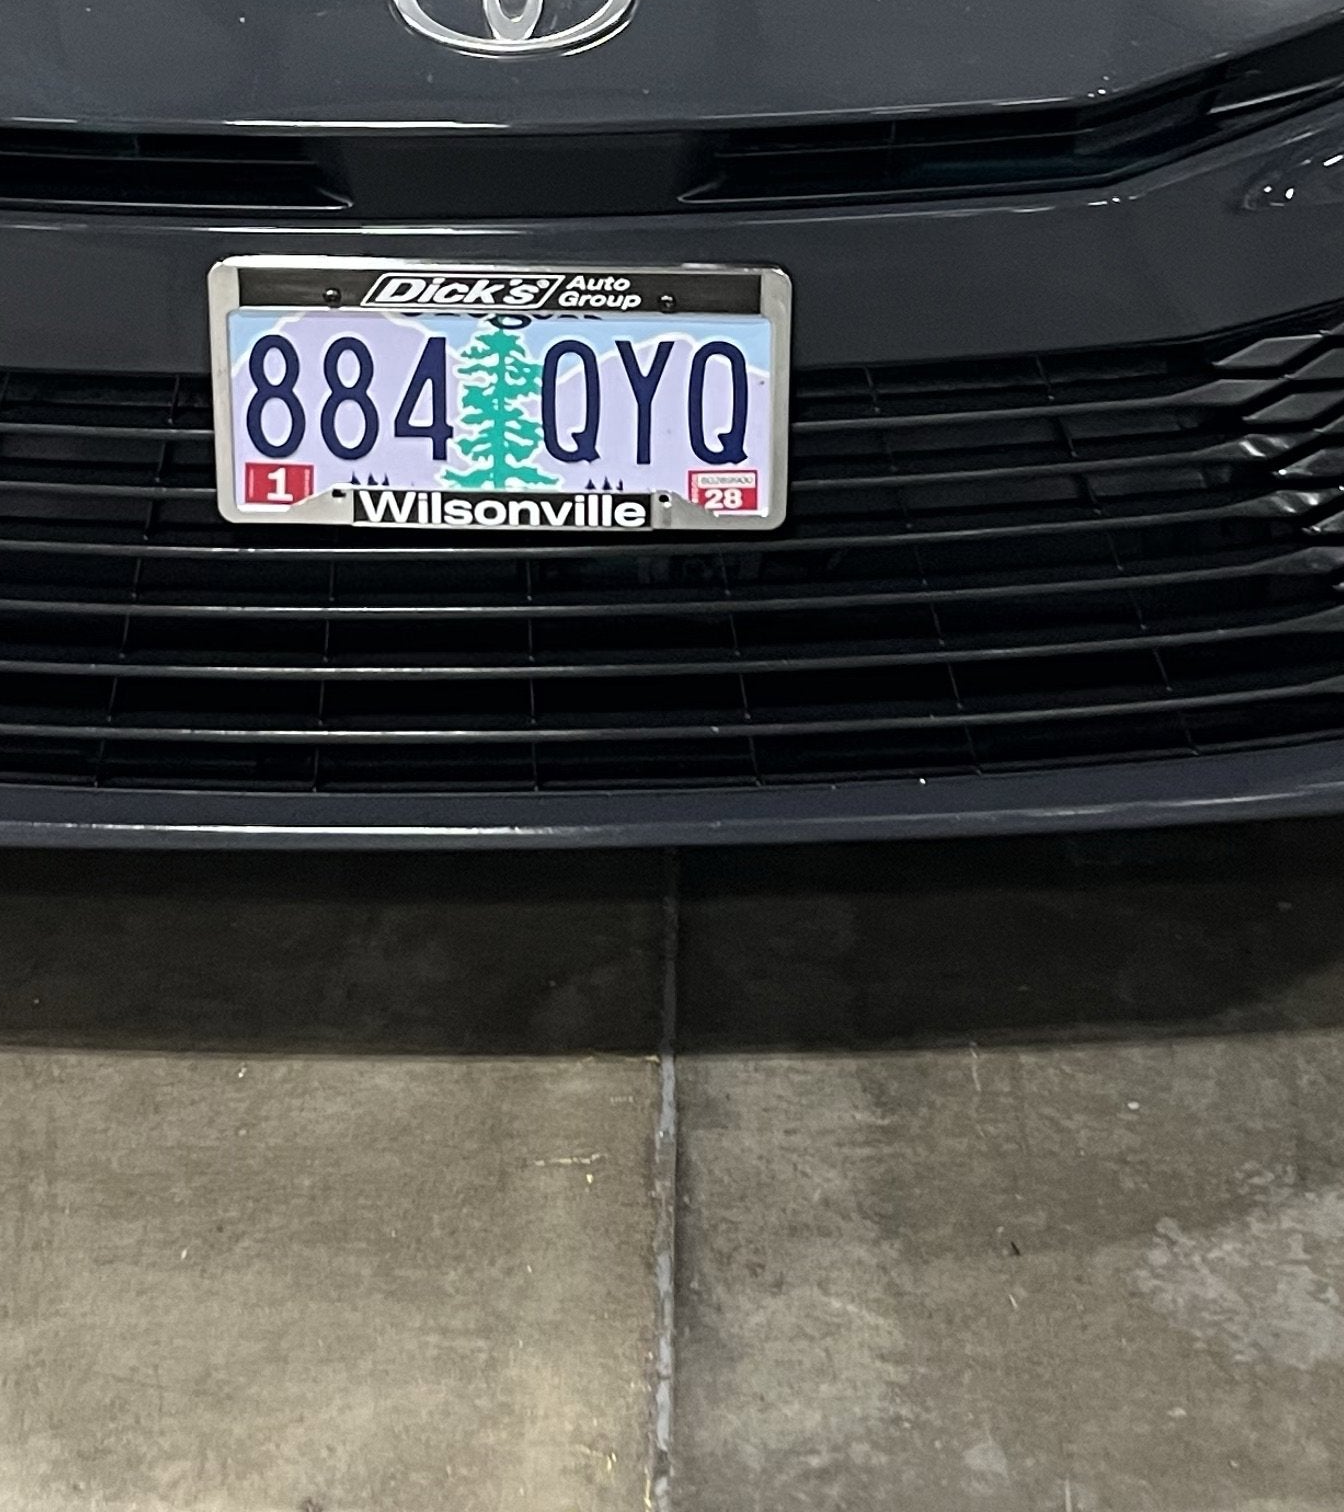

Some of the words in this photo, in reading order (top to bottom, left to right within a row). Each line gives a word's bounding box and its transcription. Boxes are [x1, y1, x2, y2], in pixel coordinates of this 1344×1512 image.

[565, 274, 632, 292] Auto
[558, 290, 643, 311] Group
[246, 333, 454, 462] 884
[541, 339, 749, 465] QYQ
[265, 466, 295, 502] 1
[358, 489, 647, 528] Wilsonville
[704, 488, 744, 510] 28
